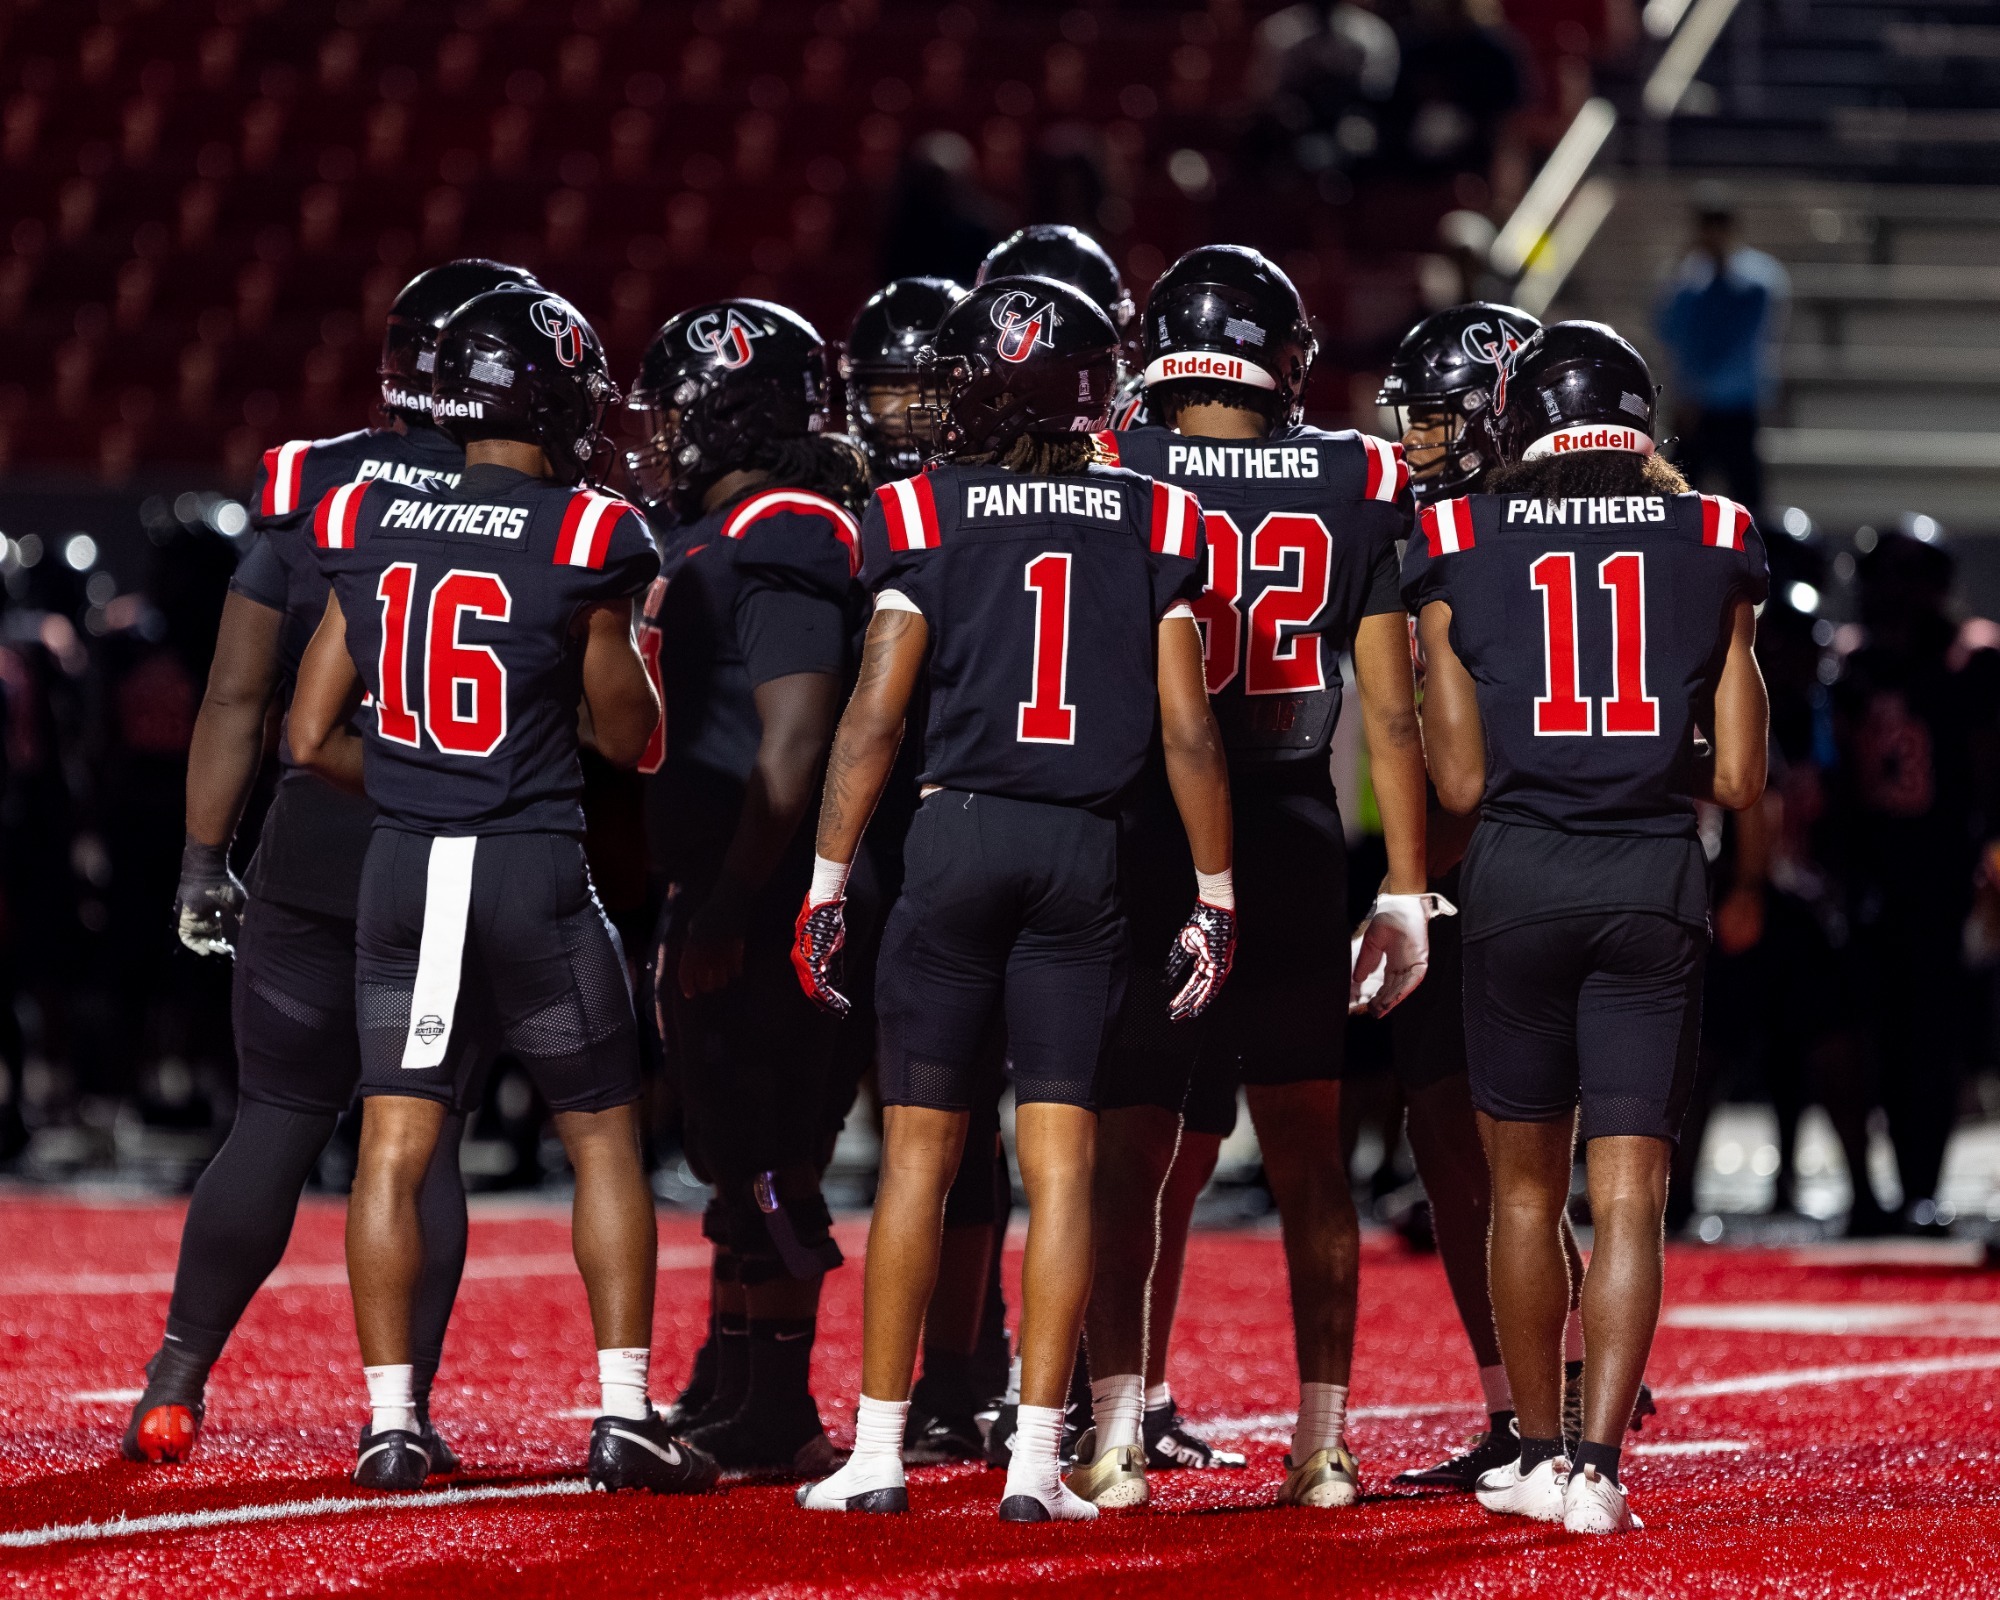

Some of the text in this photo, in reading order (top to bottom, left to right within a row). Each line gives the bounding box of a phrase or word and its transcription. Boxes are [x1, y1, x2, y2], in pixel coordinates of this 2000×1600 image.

[1162, 357, 1243, 380] Riddell
[1553, 430, 1636, 452] Riddell
[353, 459, 463, 490] PANTH
[1168, 445, 1319, 479] PANTHERS
[380, 498, 528, 540] PANTHERS
[967, 482, 1121, 521] PANTHERS
[1507, 496, 1666, 524] PANTHERS
[376, 562, 512, 757] 16
[1016, 552, 1076, 745] 1
[1529, 552, 1660, 737] 11
